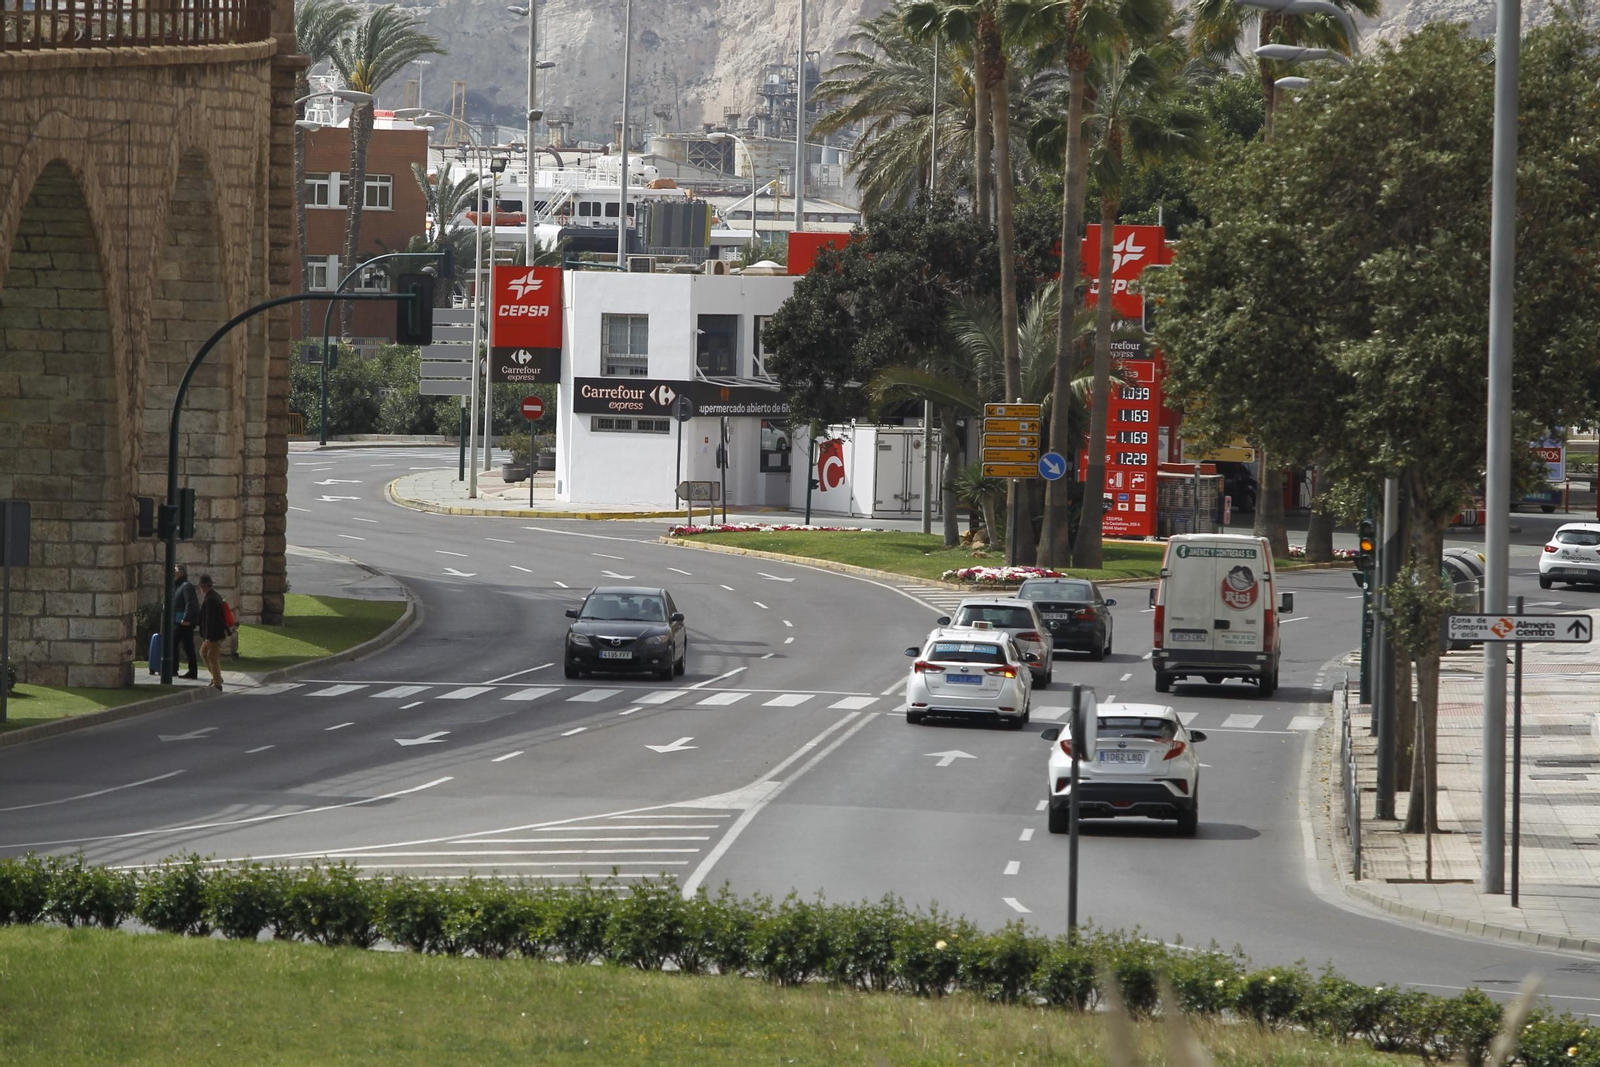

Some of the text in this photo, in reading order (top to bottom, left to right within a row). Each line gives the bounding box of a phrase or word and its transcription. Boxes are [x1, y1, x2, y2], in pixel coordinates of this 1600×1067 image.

[498, 304, 549, 318] CEPSA
[1110, 340, 1140, 350] rrefour
[501, 366, 542, 374] Carrefour
[581, 384, 646, 400] Carrefour
[608, 401, 644, 411] express
[746, 402, 772, 413] abierto
[772, 402, 780, 413] de
[1122, 410, 1149, 422] 1.169
[1121, 432, 1148, 444] 1.169
[1120, 453, 1148, 465] 1.229
[1216, 549, 1245, 558] CONTRERAS
[1225, 591, 1251, 604] Risi
[1516, 628, 1555, 637] centro
[1106, 752, 1142, 761] 1062 LBD
